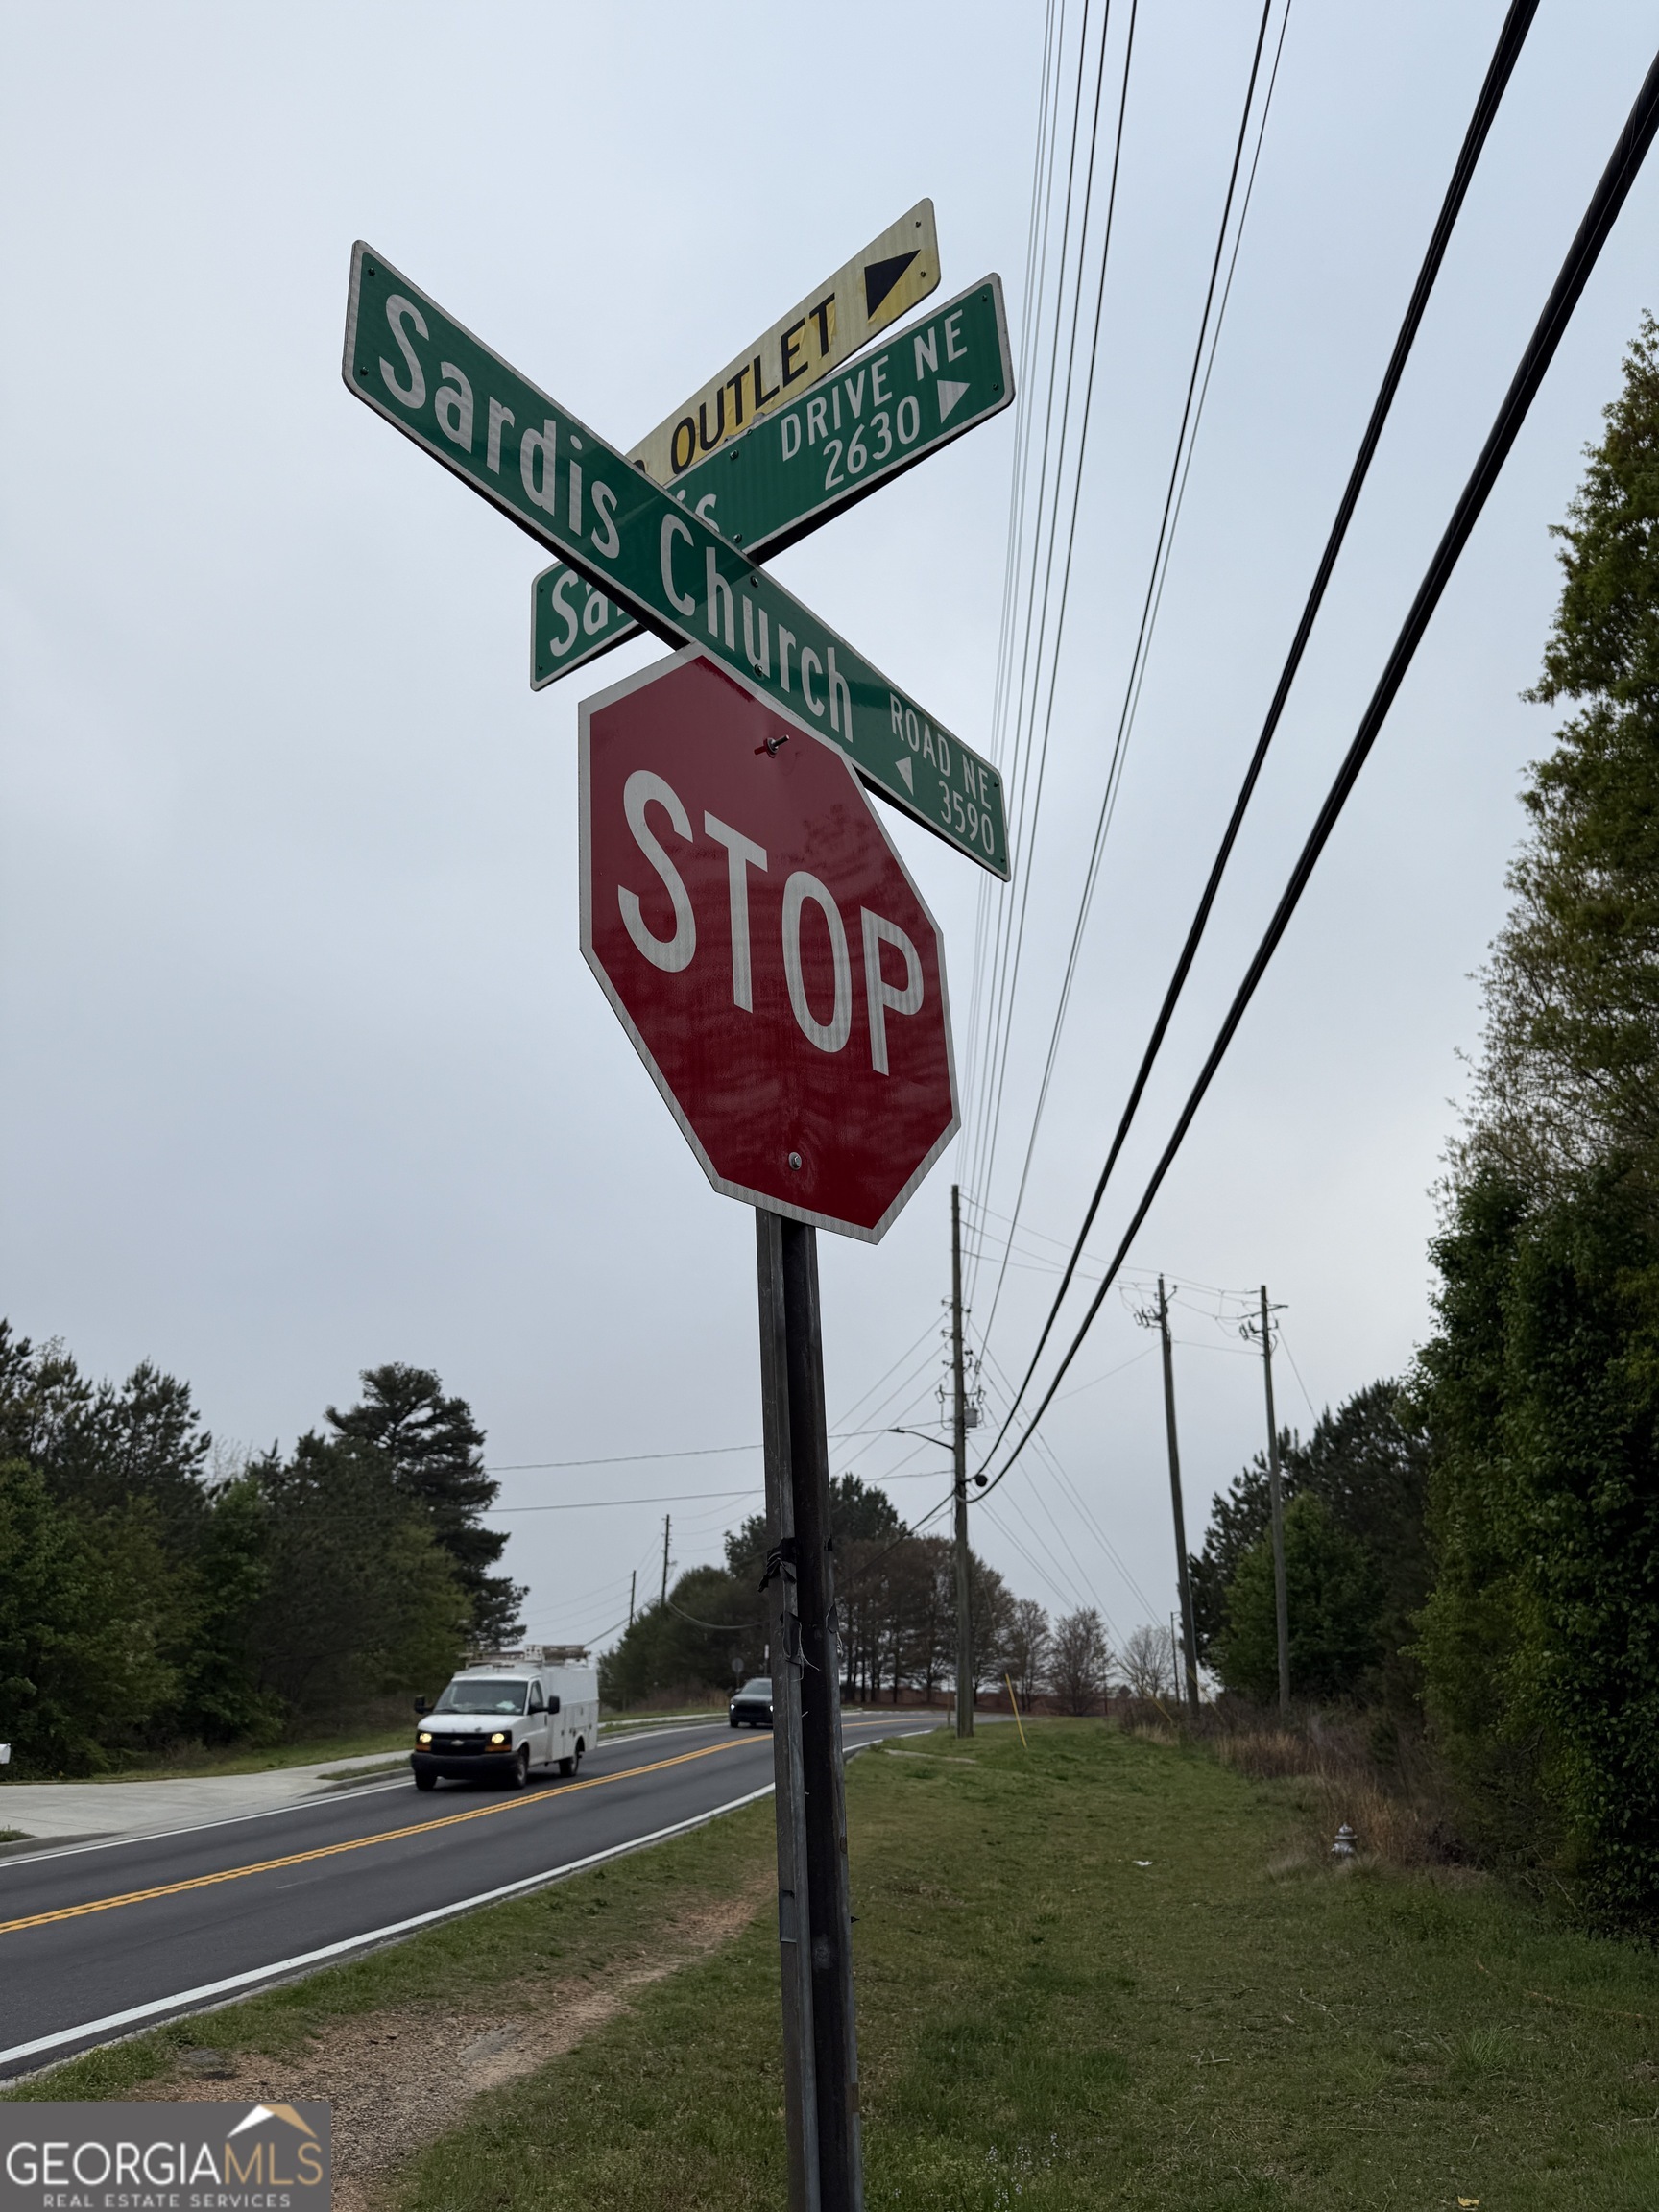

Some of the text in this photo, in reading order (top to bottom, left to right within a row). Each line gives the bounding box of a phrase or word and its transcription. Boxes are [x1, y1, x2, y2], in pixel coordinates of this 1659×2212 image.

[671, 292, 835, 474] OUTLET
[781, 309, 968, 462] DRIVE NE
[823, 395, 921, 491] 2630
[379, 294, 854, 743] Sardis Church
[889, 692, 992, 811] ROAD NE
[939, 779, 995, 856] 3590
[617, 769, 925, 1077] STOP
